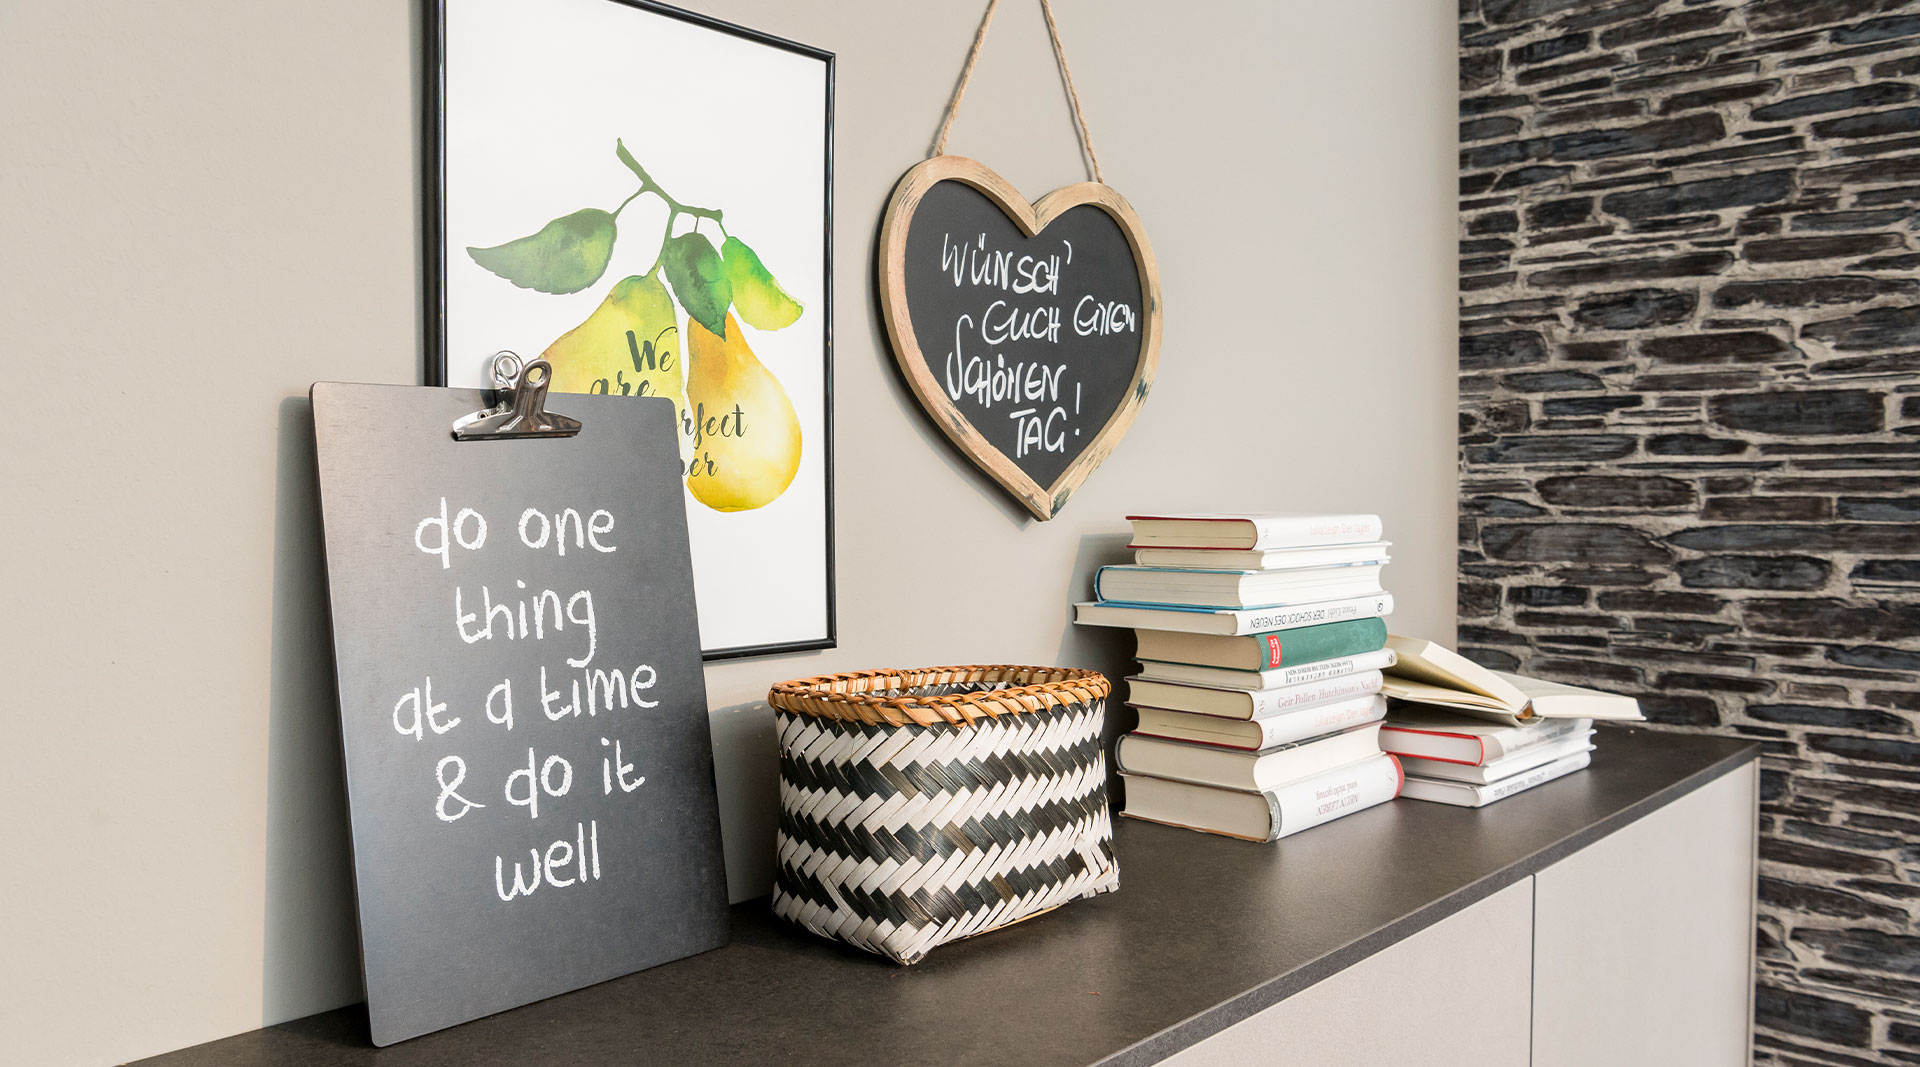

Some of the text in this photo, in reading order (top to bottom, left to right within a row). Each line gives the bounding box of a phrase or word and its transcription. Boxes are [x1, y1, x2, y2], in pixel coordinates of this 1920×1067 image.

[625, 326, 678, 373] We
[946, 314, 1067, 408] SCHÖNEN
[677, 402, 748, 450] rfect
[1009, 382, 1081, 458] TAG!
[414, 496, 617, 570] do one
[455, 579, 598, 669] thing
[1249, 616, 1274, 629] NEUEN
[1274, 615, 1287, 626] DES
[1286, 611, 1312, 625] SCHOCK
[1312, 609, 1325, 621] DER
[392, 664, 660, 742] at a time
[1278, 695, 1294, 709] Geir
[1295, 692, 1316, 705] Pollen
[1346, 709, 1358, 721] Der
[435, 736, 646, 823] & do it
[1315, 800, 1339, 817] LEBEN
[494, 820, 601, 902] well
